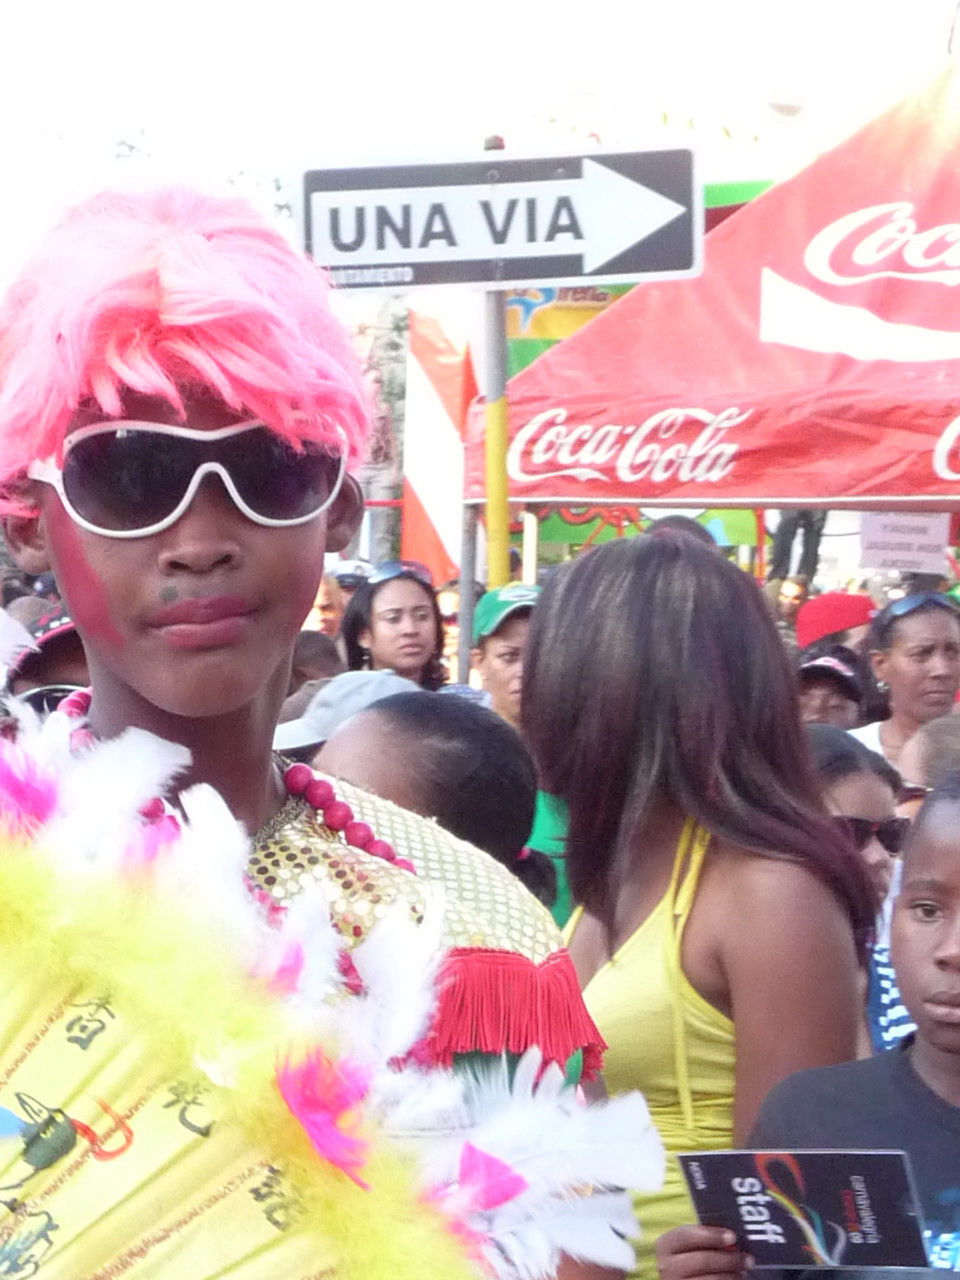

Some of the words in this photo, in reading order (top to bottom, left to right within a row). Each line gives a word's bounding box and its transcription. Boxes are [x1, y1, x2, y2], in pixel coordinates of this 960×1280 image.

[328, 203, 459, 253] UNA
[479, 195, 585, 249] VIA
[506, 407, 754, 482] Coca-Cola
[731, 1177, 787, 1244] staff
